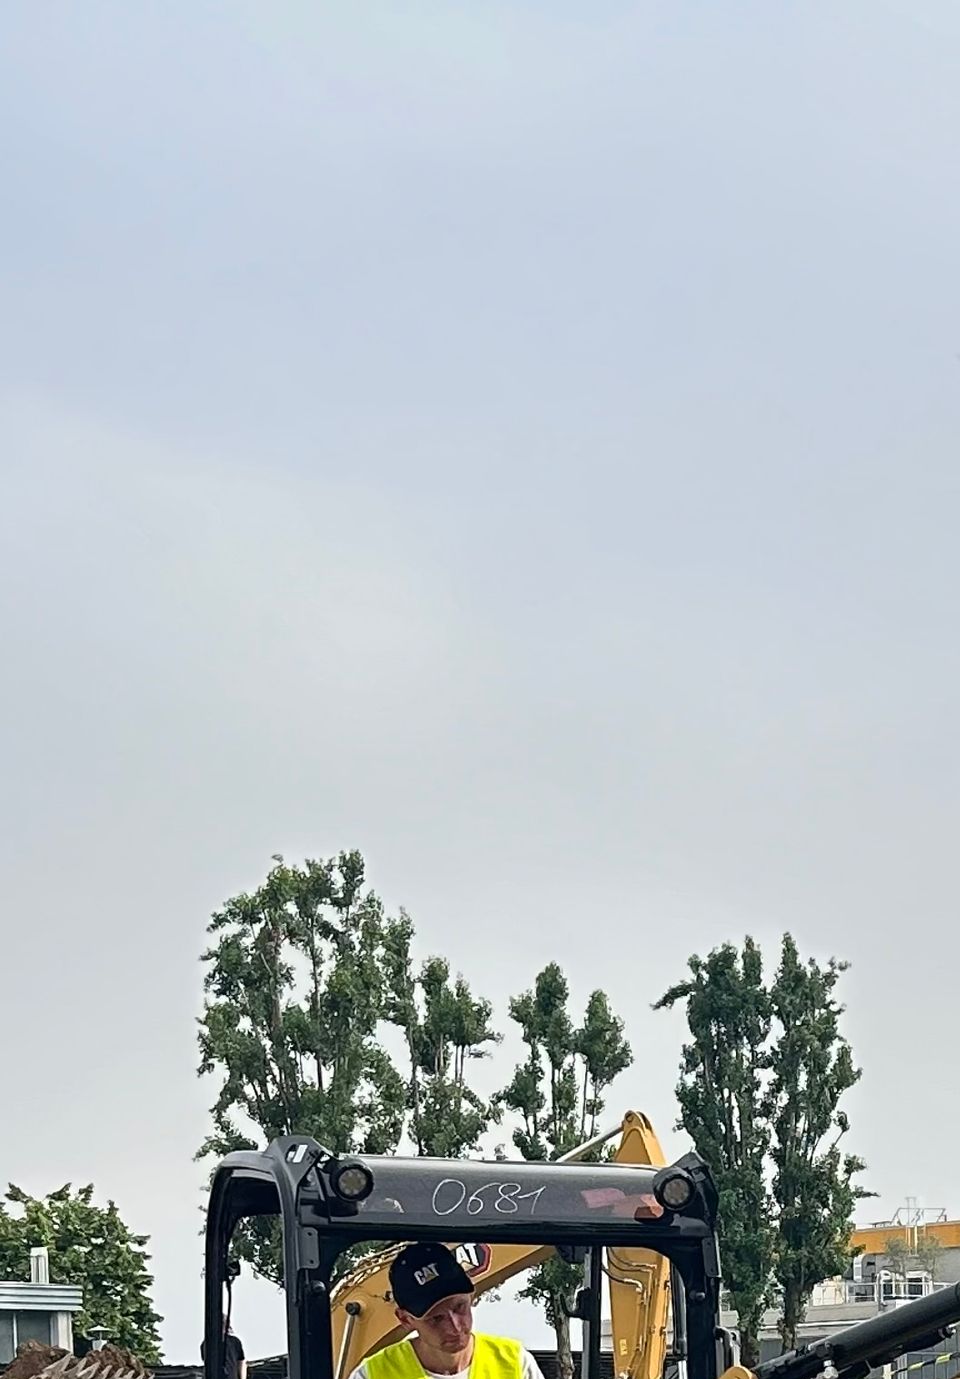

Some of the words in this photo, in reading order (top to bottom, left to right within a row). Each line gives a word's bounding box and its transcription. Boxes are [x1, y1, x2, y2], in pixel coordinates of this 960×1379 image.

[432, 1179, 546, 1215] 0681
[456, 1243, 479, 1266] AT
[414, 1263, 439, 1285] CAT
